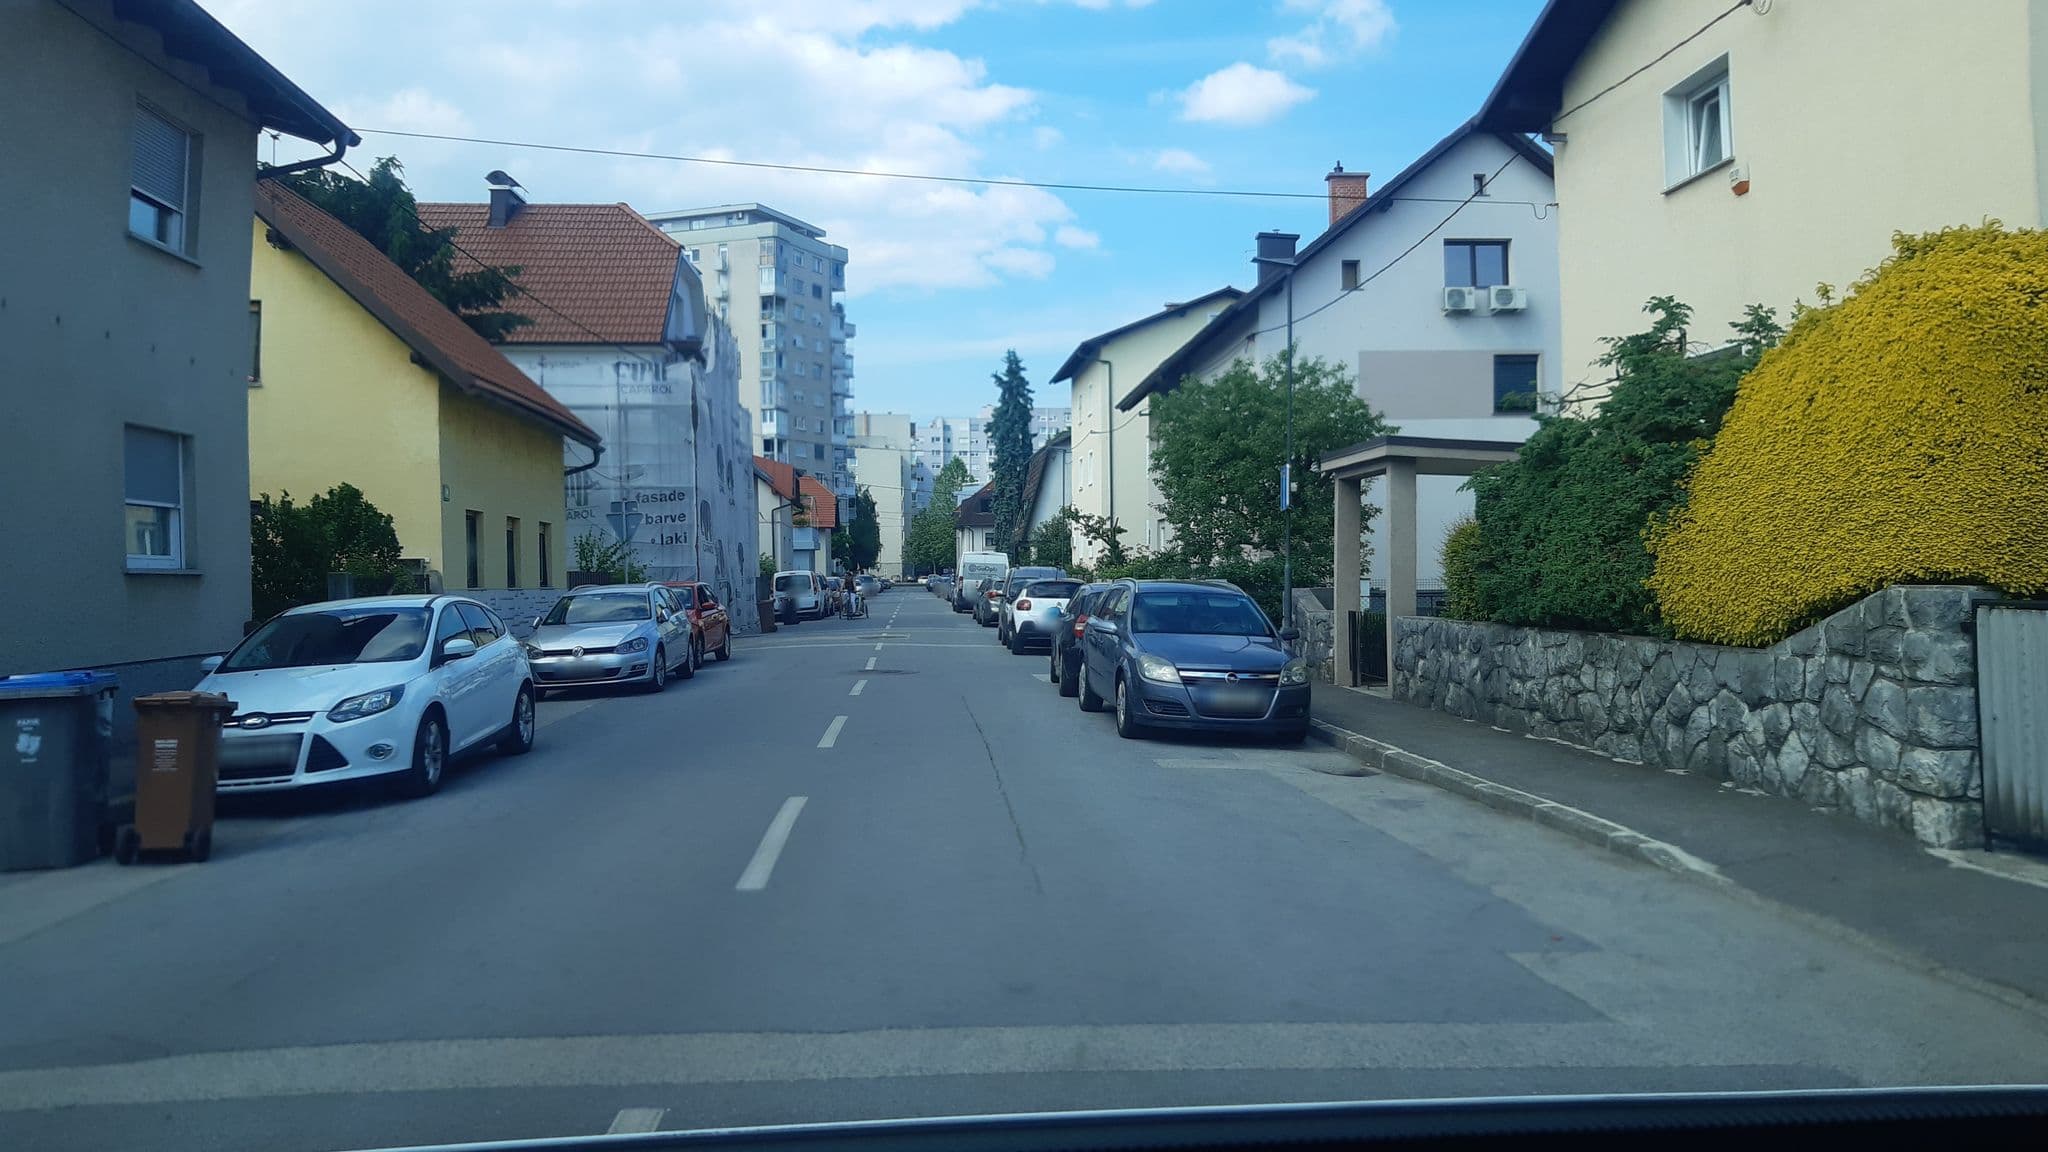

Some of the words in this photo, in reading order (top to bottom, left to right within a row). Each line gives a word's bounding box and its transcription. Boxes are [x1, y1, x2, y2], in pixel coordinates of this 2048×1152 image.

[635, 490, 686, 504] fasade
[565, 507, 596, 521] AROL
[645, 512, 687, 525] barve
[660, 531, 688, 546] laki
